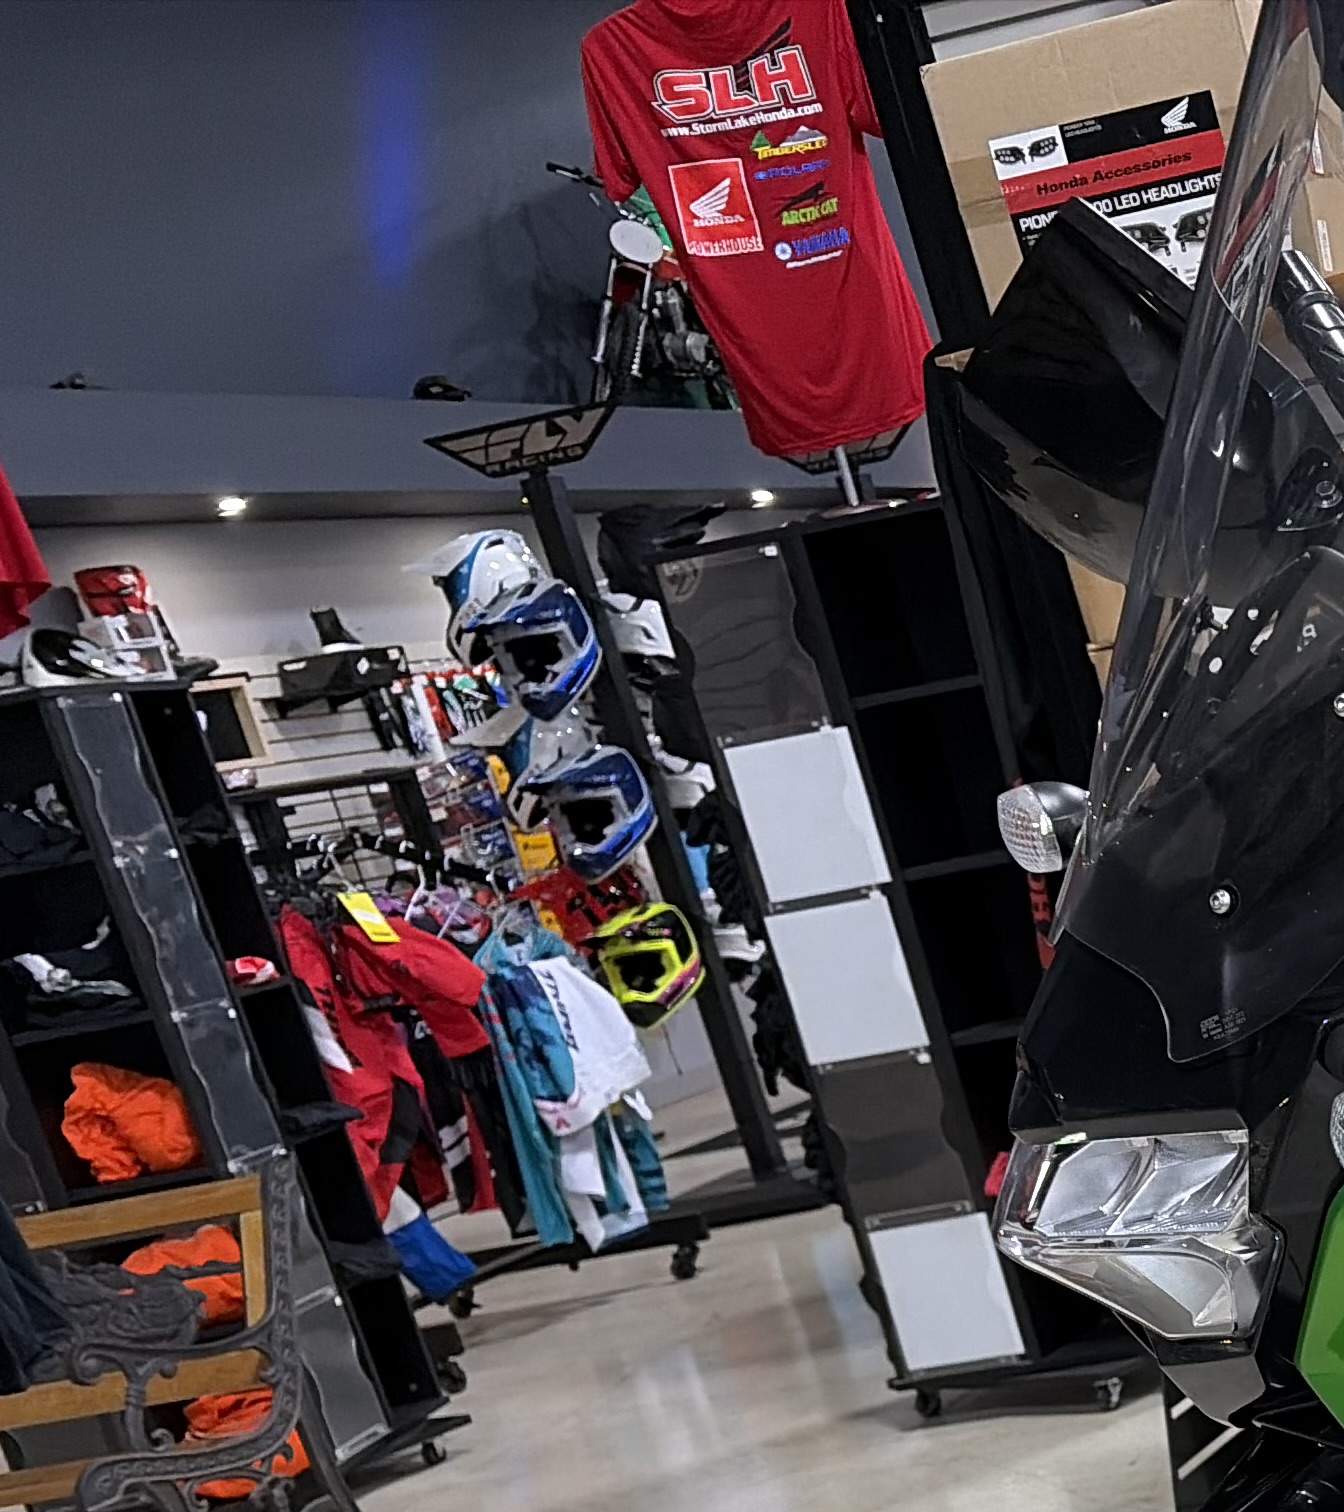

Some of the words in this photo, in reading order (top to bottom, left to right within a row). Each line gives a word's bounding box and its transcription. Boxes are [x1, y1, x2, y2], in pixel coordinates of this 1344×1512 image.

[653, 46, 815, 122] SLH
[660, 103, 823, 137] www.StormLakeHonda.com
[1163, 121, 1198, 134] HONDA
[1036, 175, 1089, 196] Honda
[1092, 152, 1192, 183] Accessories
[1114, 190, 1140, 209] LED
[1142, 173, 1222, 202] HEADLIGHTS
[693, 214, 745, 227] HONDA
[688, 235, 763, 257] POWERHOUSE
[470, 406, 606, 464] FLY
[485, 444, 584, 474] RACING
